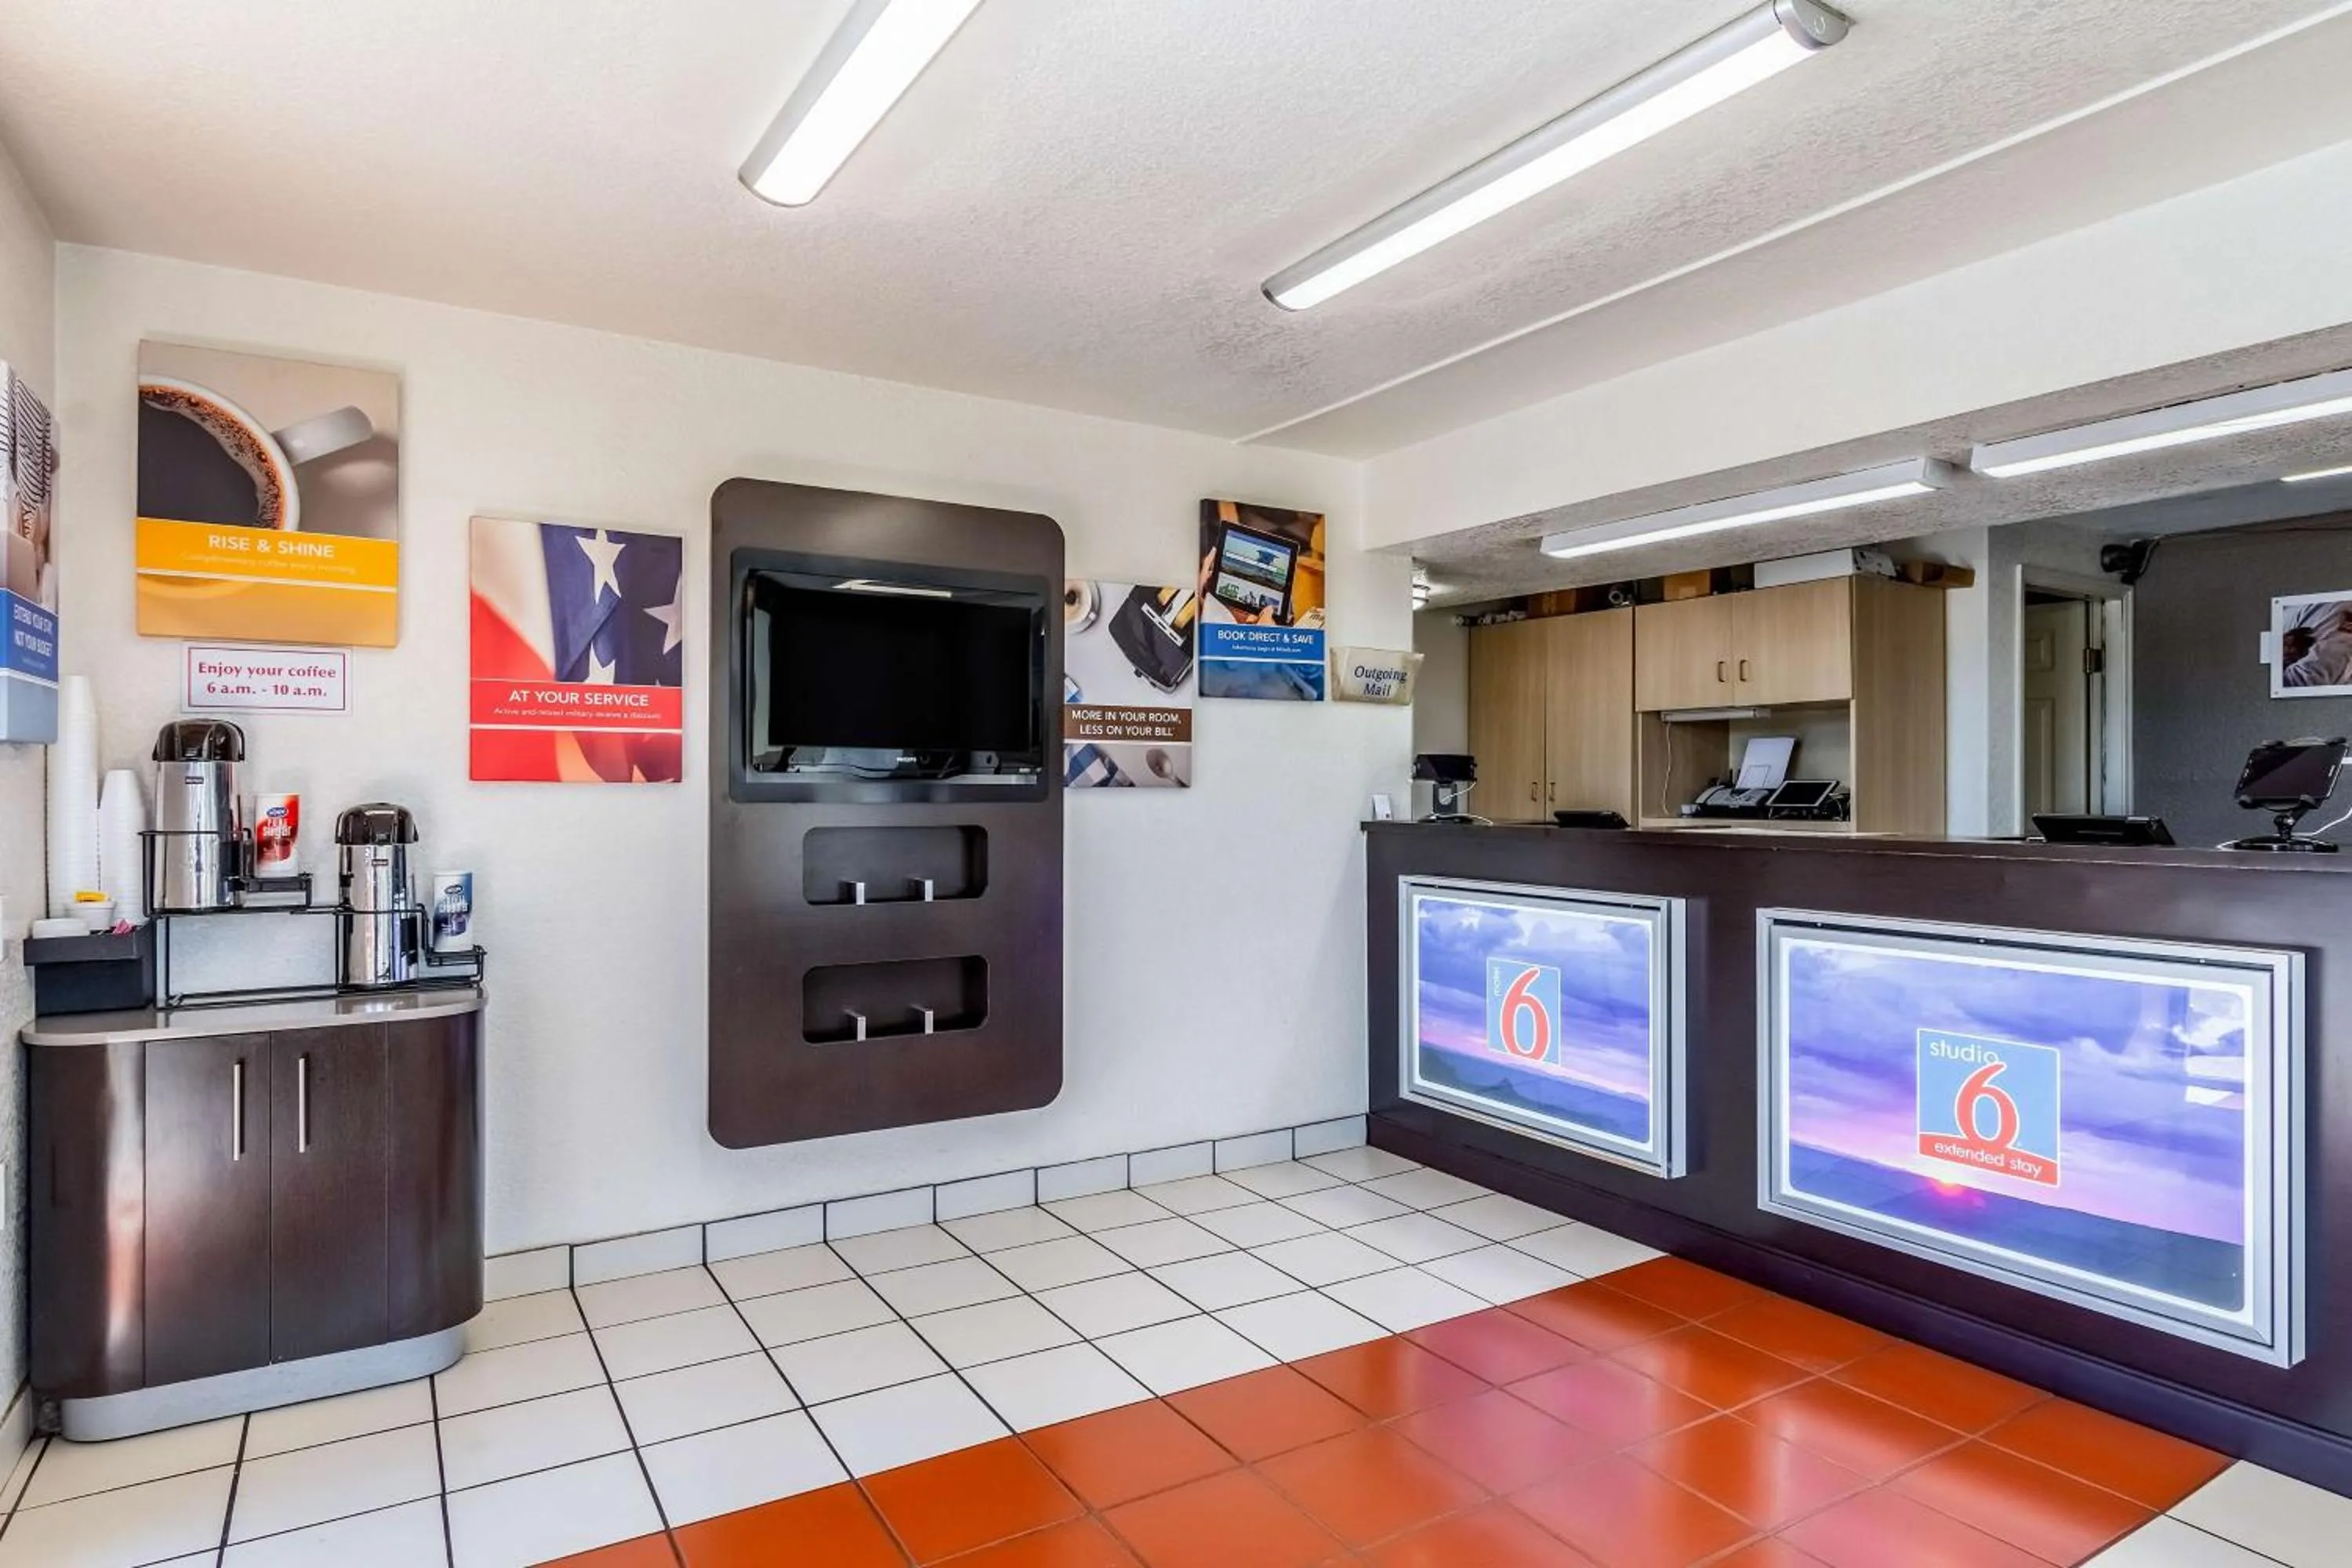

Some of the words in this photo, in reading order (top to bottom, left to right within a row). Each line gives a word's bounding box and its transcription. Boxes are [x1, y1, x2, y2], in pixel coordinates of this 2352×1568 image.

[208, 534, 250, 551] RISE
[256, 539, 271, 554] &
[277, 540, 336, 558] SHINE
[1218, 630, 1246, 641] BOOK
[1248, 631, 1281, 642] DIRECT
[1283, 634, 1290, 644] &
[1291, 634, 1315, 644] SAVE
[198, 662, 242, 677] Enjoy
[247, 666, 283, 679] your
[288, 665, 336, 678] coffee
[1354, 665, 1407, 684] Outgoing
[206, 681, 216, 694] 6
[220, 684, 256, 695] a.m.
[274, 684, 289, 695] 10
[292, 685, 328, 697] a.m.
[509, 689, 531, 702] AT
[534, 690, 580, 704] YOUR
[584, 692, 650, 706] SERVICE
[1364, 683, 1392, 696] Mail
[1072, 710, 1102, 720] MORE
[1105, 711, 1116, 721] IN
[1119, 711, 1145, 722] YOUR
[1149, 712, 1181, 724] ROOM,
[1080, 724, 1102, 735] LESS
[1106, 724, 1122, 735] ON
[1124, 725, 1152, 736] YOUR
[263, 826, 292, 840] sugar
[1500, 967, 1551, 1063] 6
[1929, 1040, 1999, 1065] studio
[1955, 1062, 2020, 1149] 6
[1933, 1142, 2005, 1167] extended
[2009, 1159, 2043, 1179] stay
